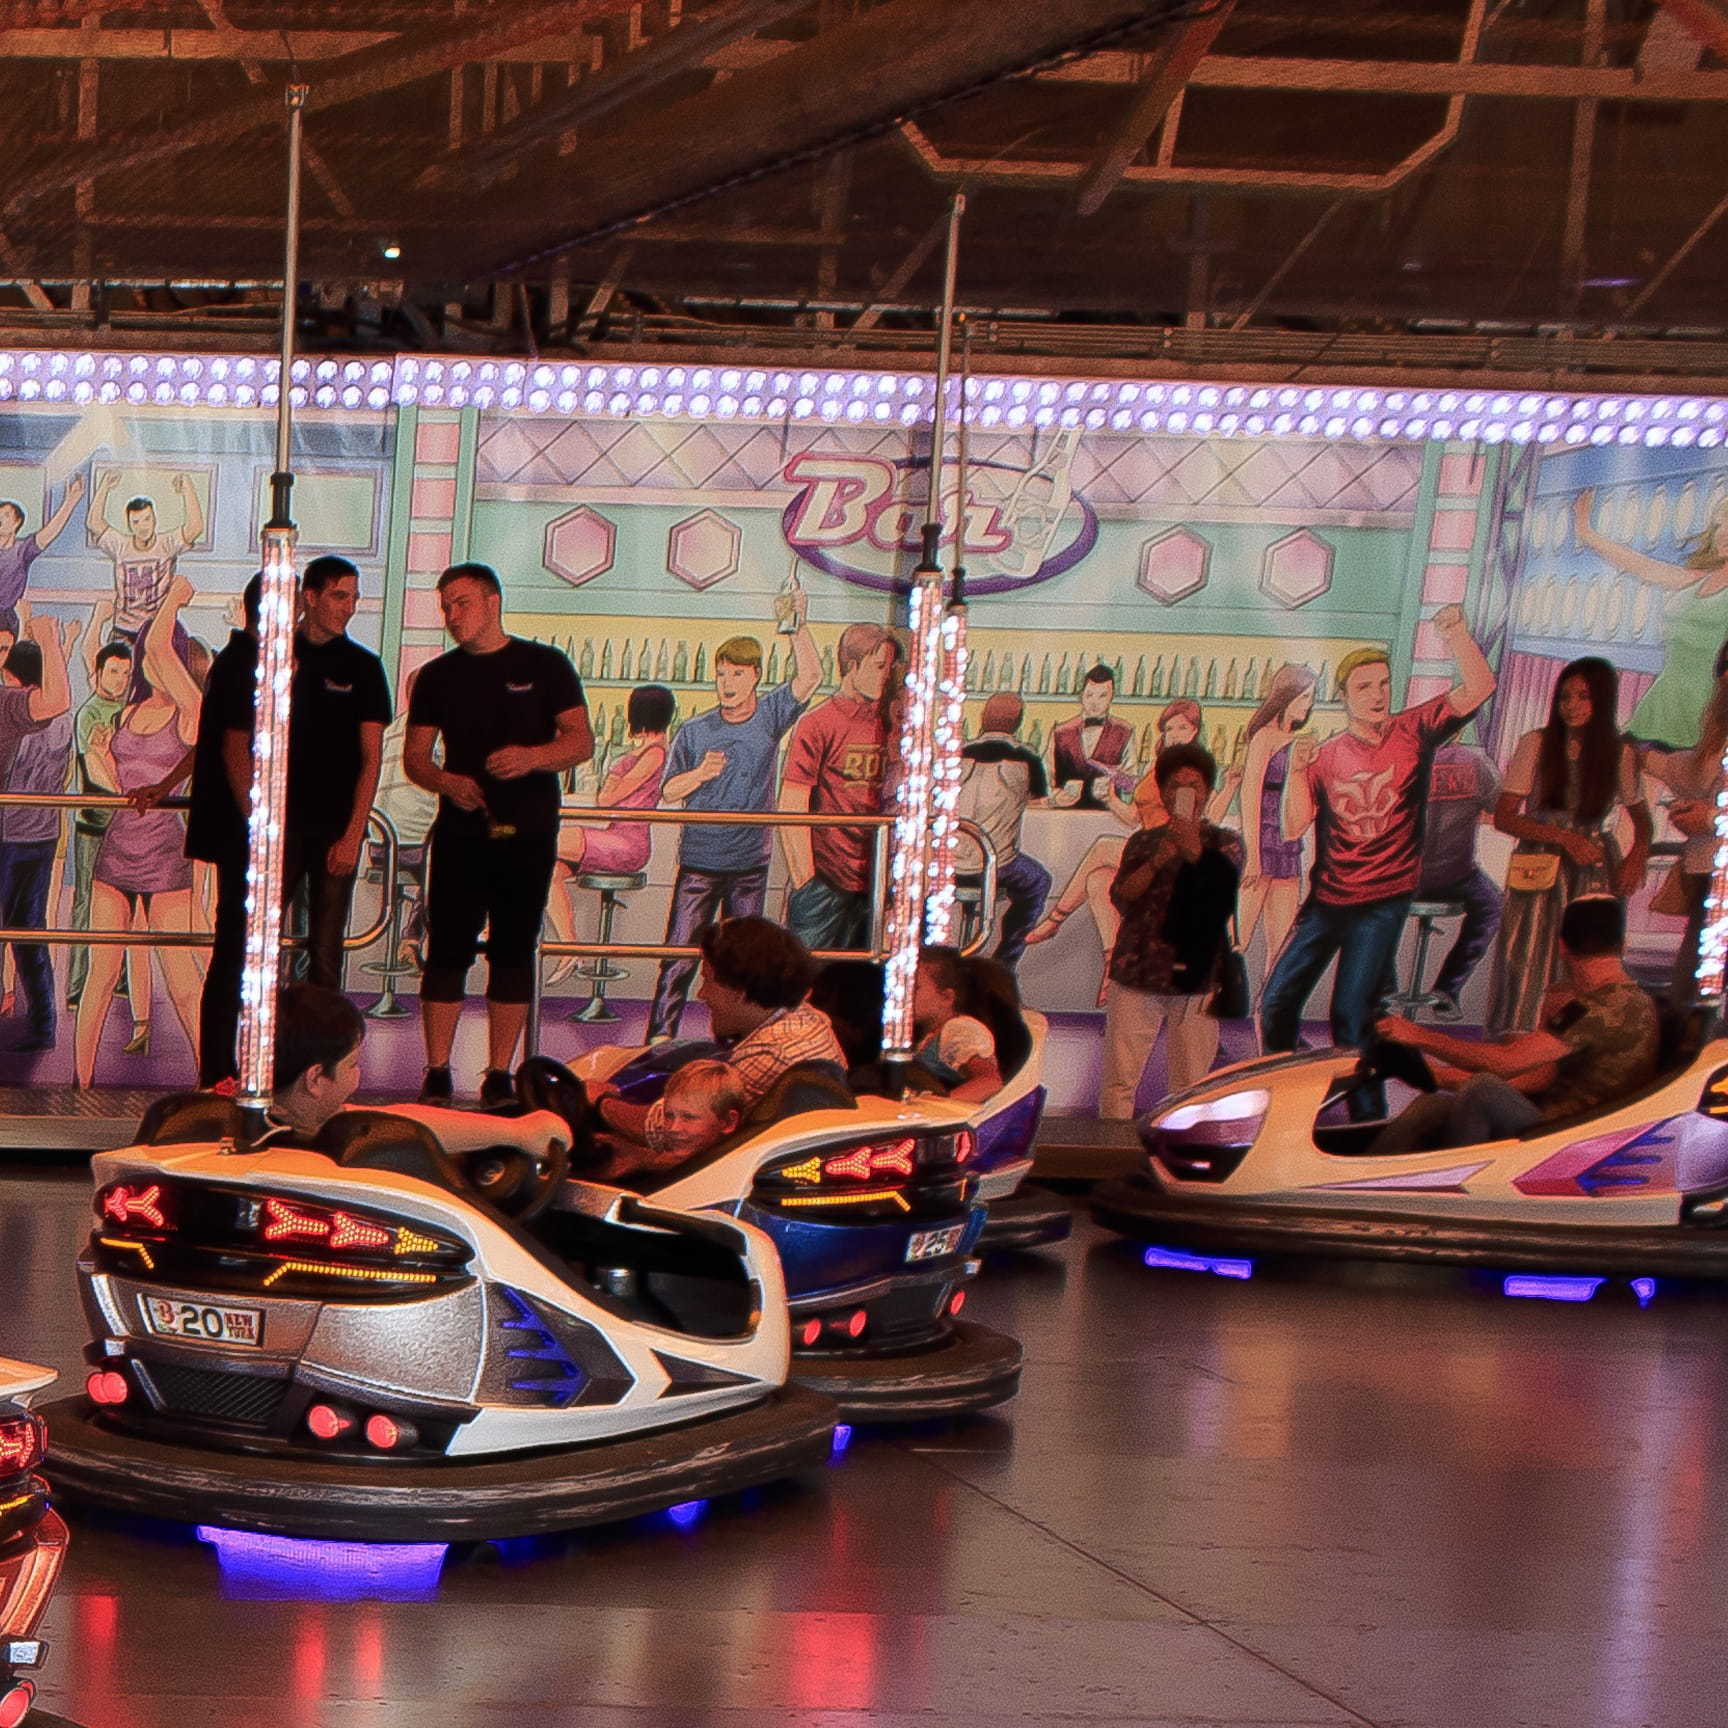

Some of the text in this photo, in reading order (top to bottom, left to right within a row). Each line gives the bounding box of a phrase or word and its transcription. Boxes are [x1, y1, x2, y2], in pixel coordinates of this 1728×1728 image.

[783, 451, 1012, 553] Bar
[181, 1305, 223, 1337] 20
[225, 1313, 253, 1327] NEW
